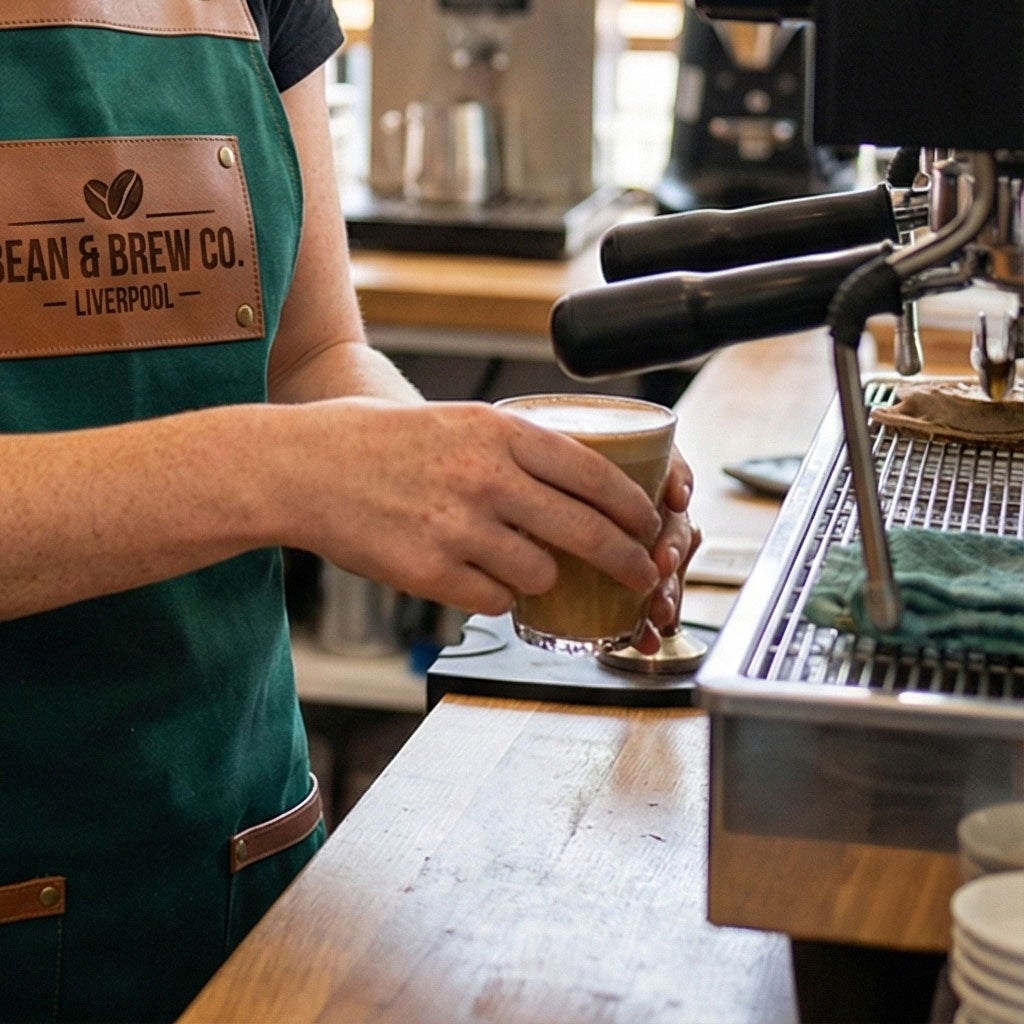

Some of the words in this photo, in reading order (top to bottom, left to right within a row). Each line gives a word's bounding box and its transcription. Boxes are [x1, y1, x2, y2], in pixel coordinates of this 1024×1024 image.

[79, 235, 101, 278] &
[108, 229, 190, 277] BREW
[199, 226, 245, 270] CO.
[75, 283, 174, 316] LIVERPOOL
